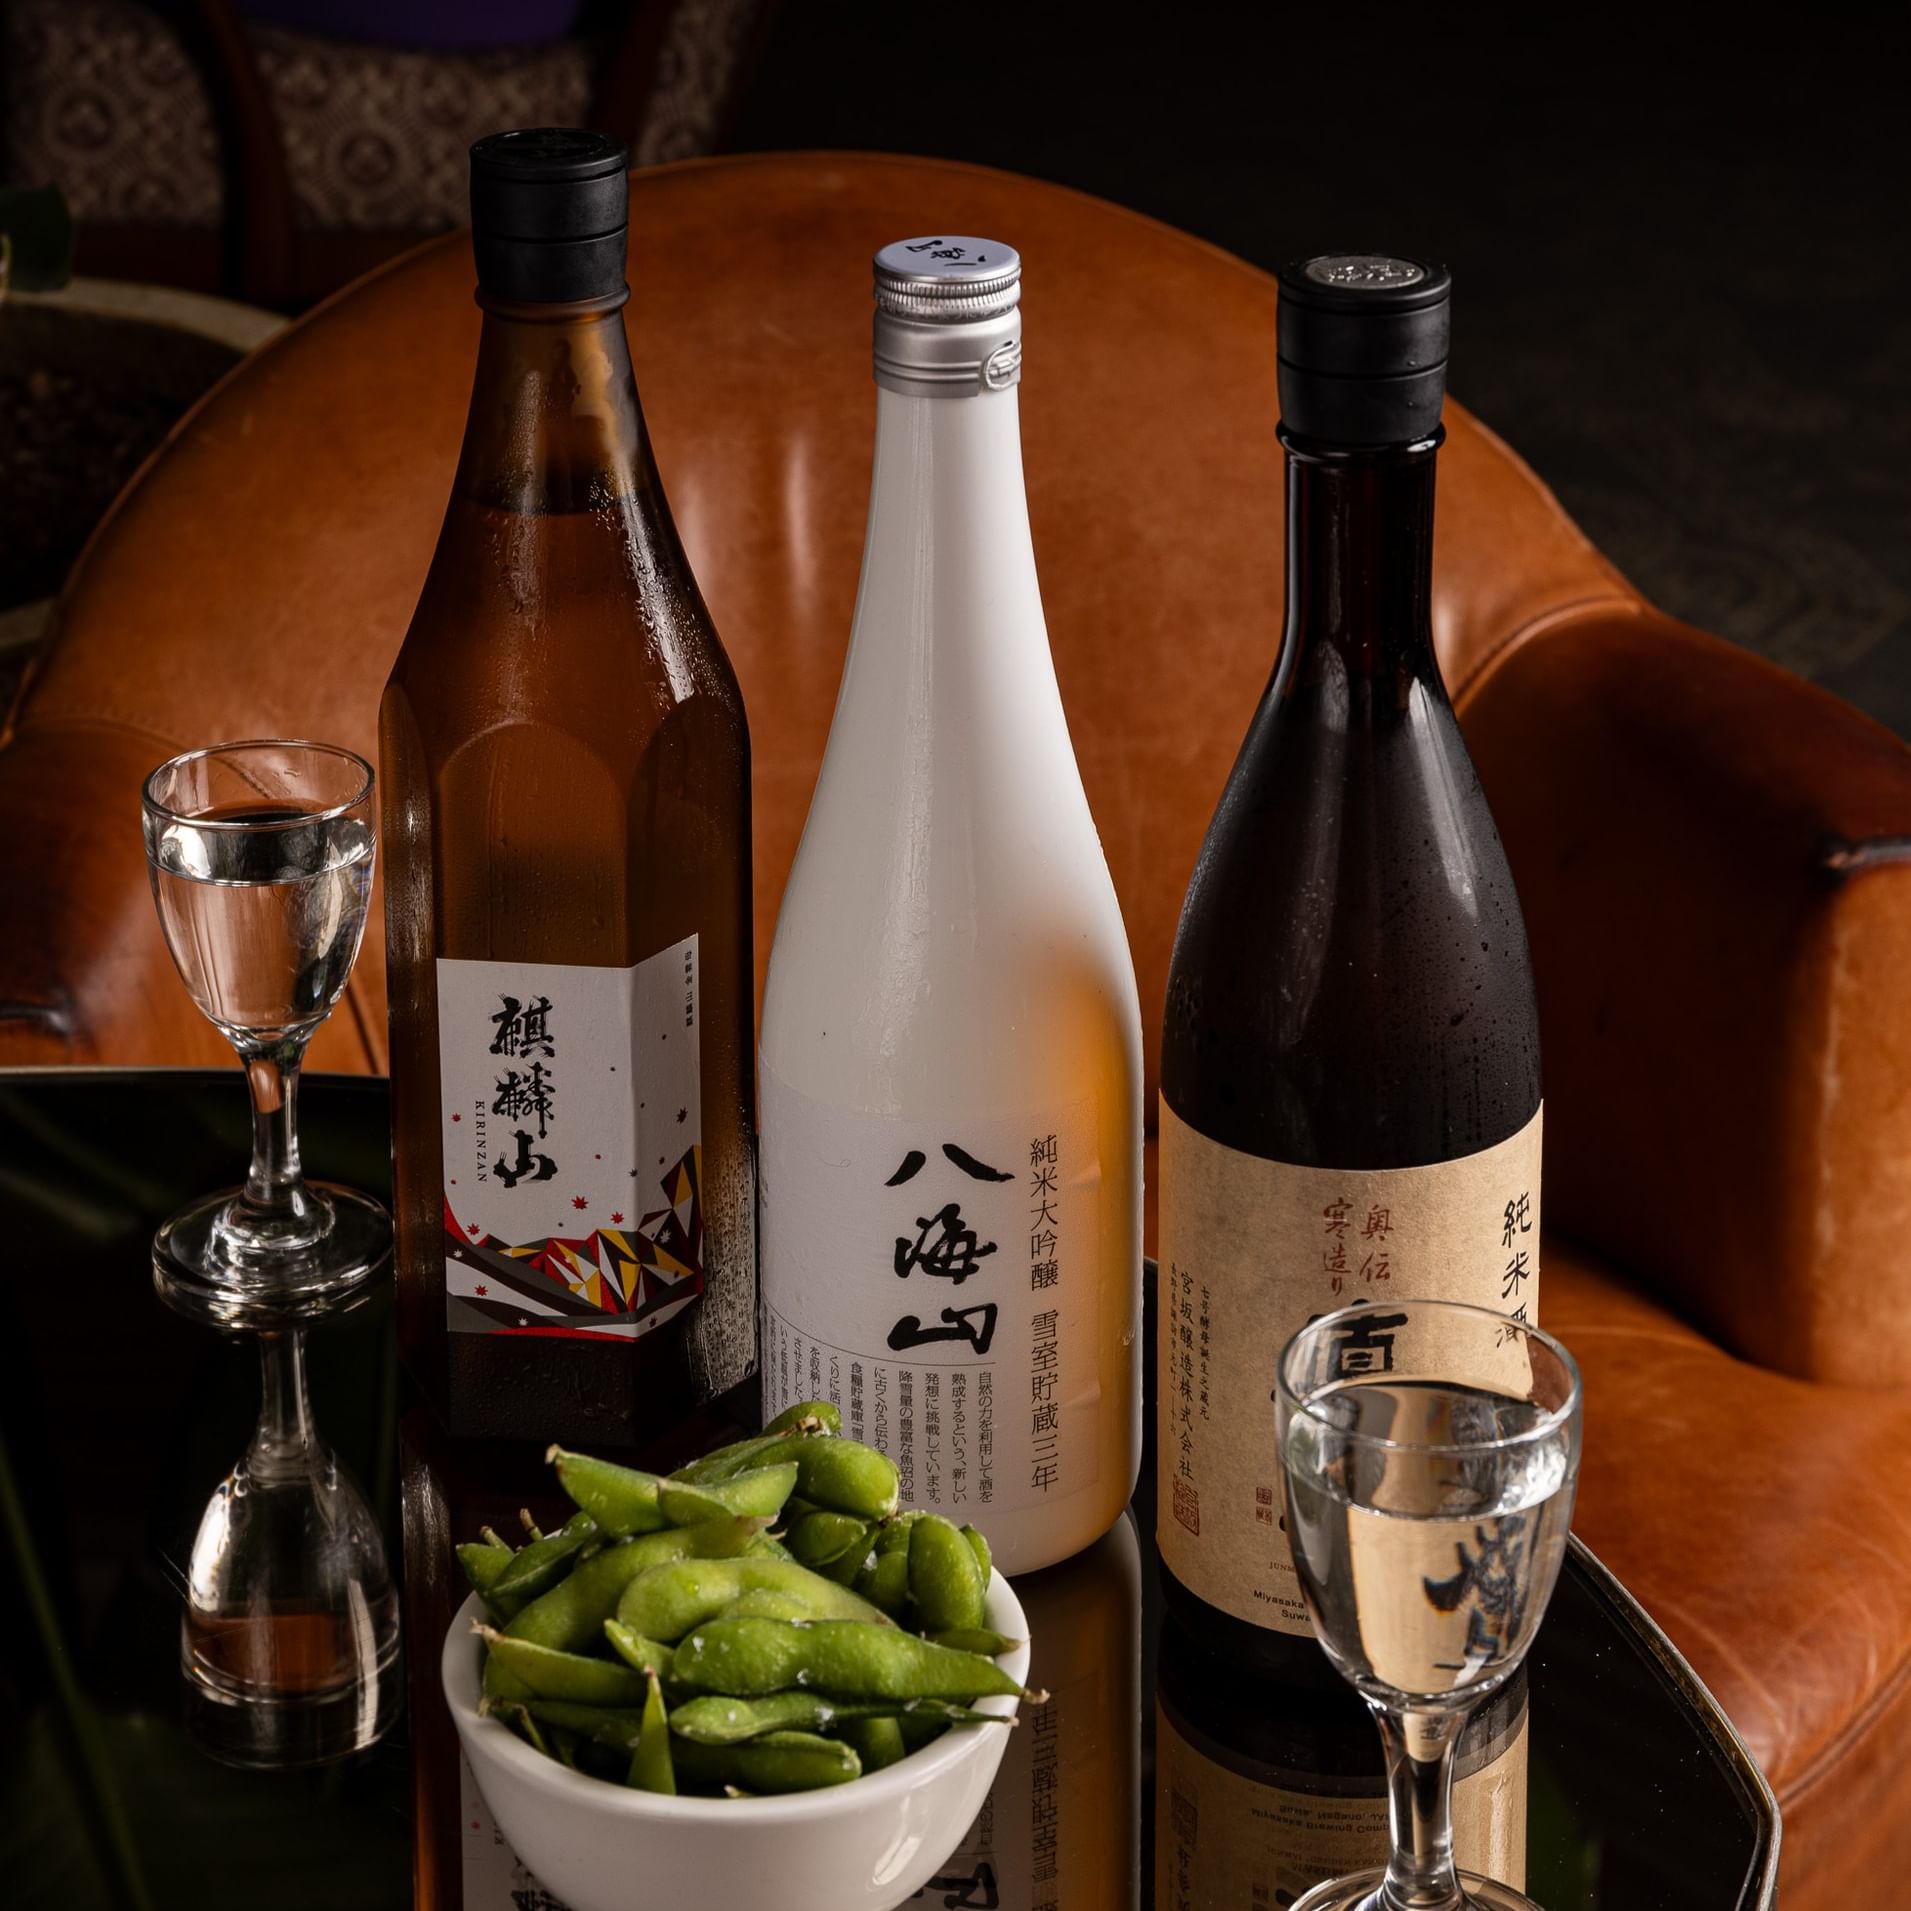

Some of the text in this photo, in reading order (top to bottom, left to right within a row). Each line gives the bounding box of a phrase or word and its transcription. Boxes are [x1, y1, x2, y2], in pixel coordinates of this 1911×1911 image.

[474, 1100, 488, 1183] KIRINZAN
[489, 992, 558, 1188] 麒麟山
[884, 1143, 1016, 1355] 八海山
[1323, 1197, 1353, 1296] 寒造り
[1360, 1204, 1394, 1282] 奥伝
[1030, 1134, 1060, 1494] 純米大吟醸 雪室貯蔵三年
[1179, 1271, 1194, 1481] 宮坂醸造株式会社
[850, 1361, 863, 1444] 食糧貯蔵庫「雪
[924, 1372, 941, 1504] 発想に挑戦しています。
[951, 1372, 967, 1504] 熟成するという、新しい
[978, 1371, 993, 1504] 自然の力を利用して酒を
[1253, 1589, 1305, 1609] Miyasaka
